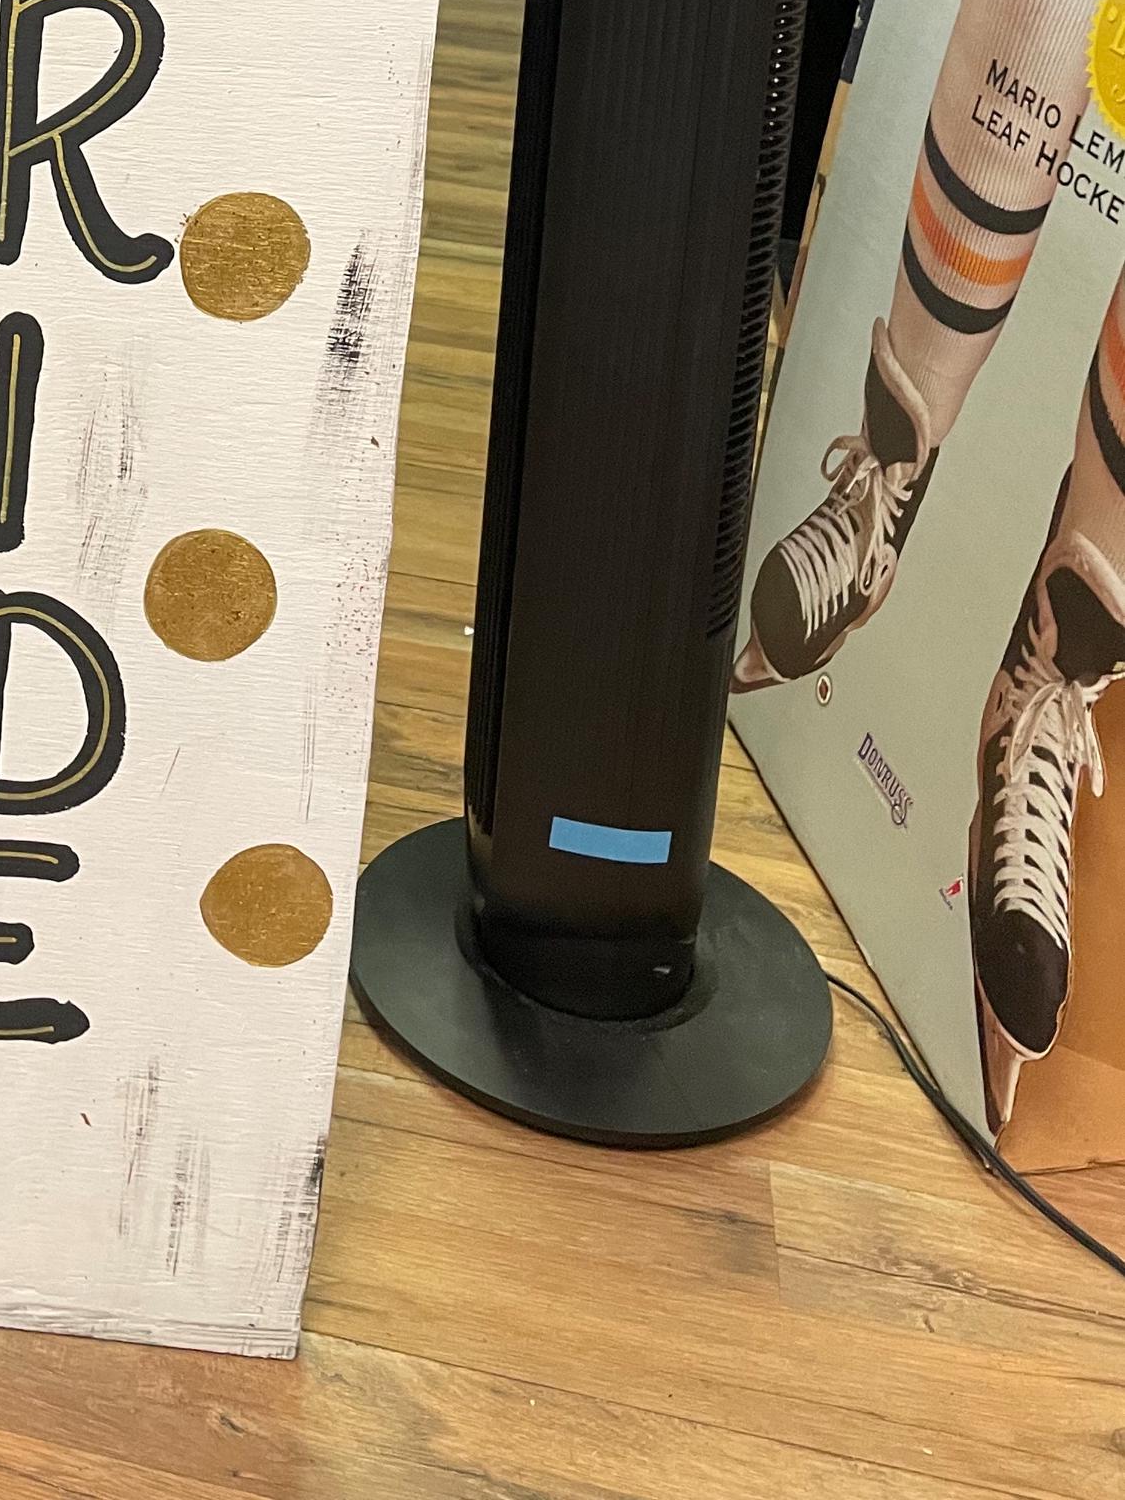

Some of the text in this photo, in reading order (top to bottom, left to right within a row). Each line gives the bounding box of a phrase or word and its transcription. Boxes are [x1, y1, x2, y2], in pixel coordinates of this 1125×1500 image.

[971, 95, 1125, 224] LEAF HOCKE
[986, 59, 1062, 129] MARIO
[1069, 115, 1125, 175] LEM
[857, 732, 914, 828] DONRUSS
